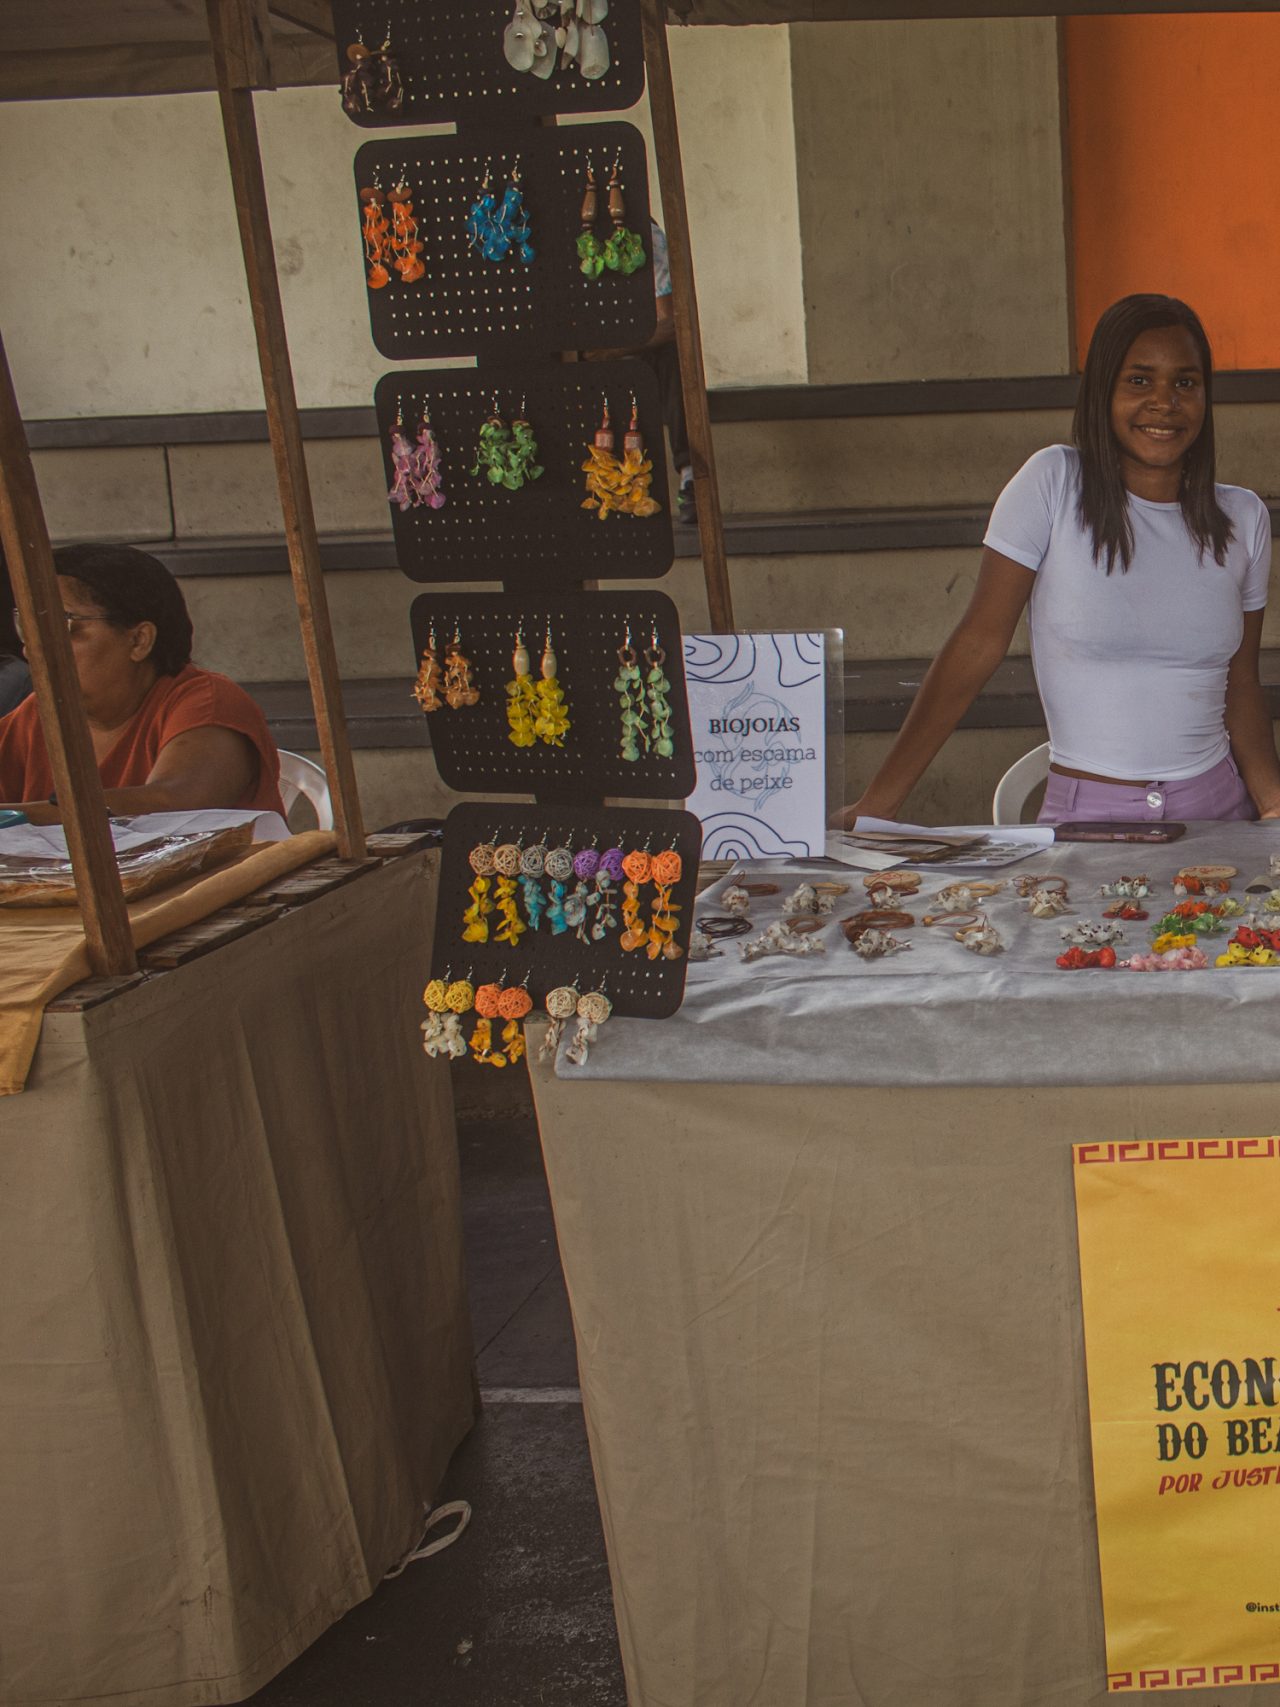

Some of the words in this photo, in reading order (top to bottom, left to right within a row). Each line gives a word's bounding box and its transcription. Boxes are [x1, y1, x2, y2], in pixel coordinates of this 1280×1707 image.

[710, 717, 800, 736] BIOJOIAS
[694, 749, 734, 763] com
[740, 747, 816, 762] escama
[710, 775, 734, 791] de
[740, 774, 793, 794] peixe
[1156, 1421, 1208, 1462] DO
[1159, 1473, 1203, 1495] POR
